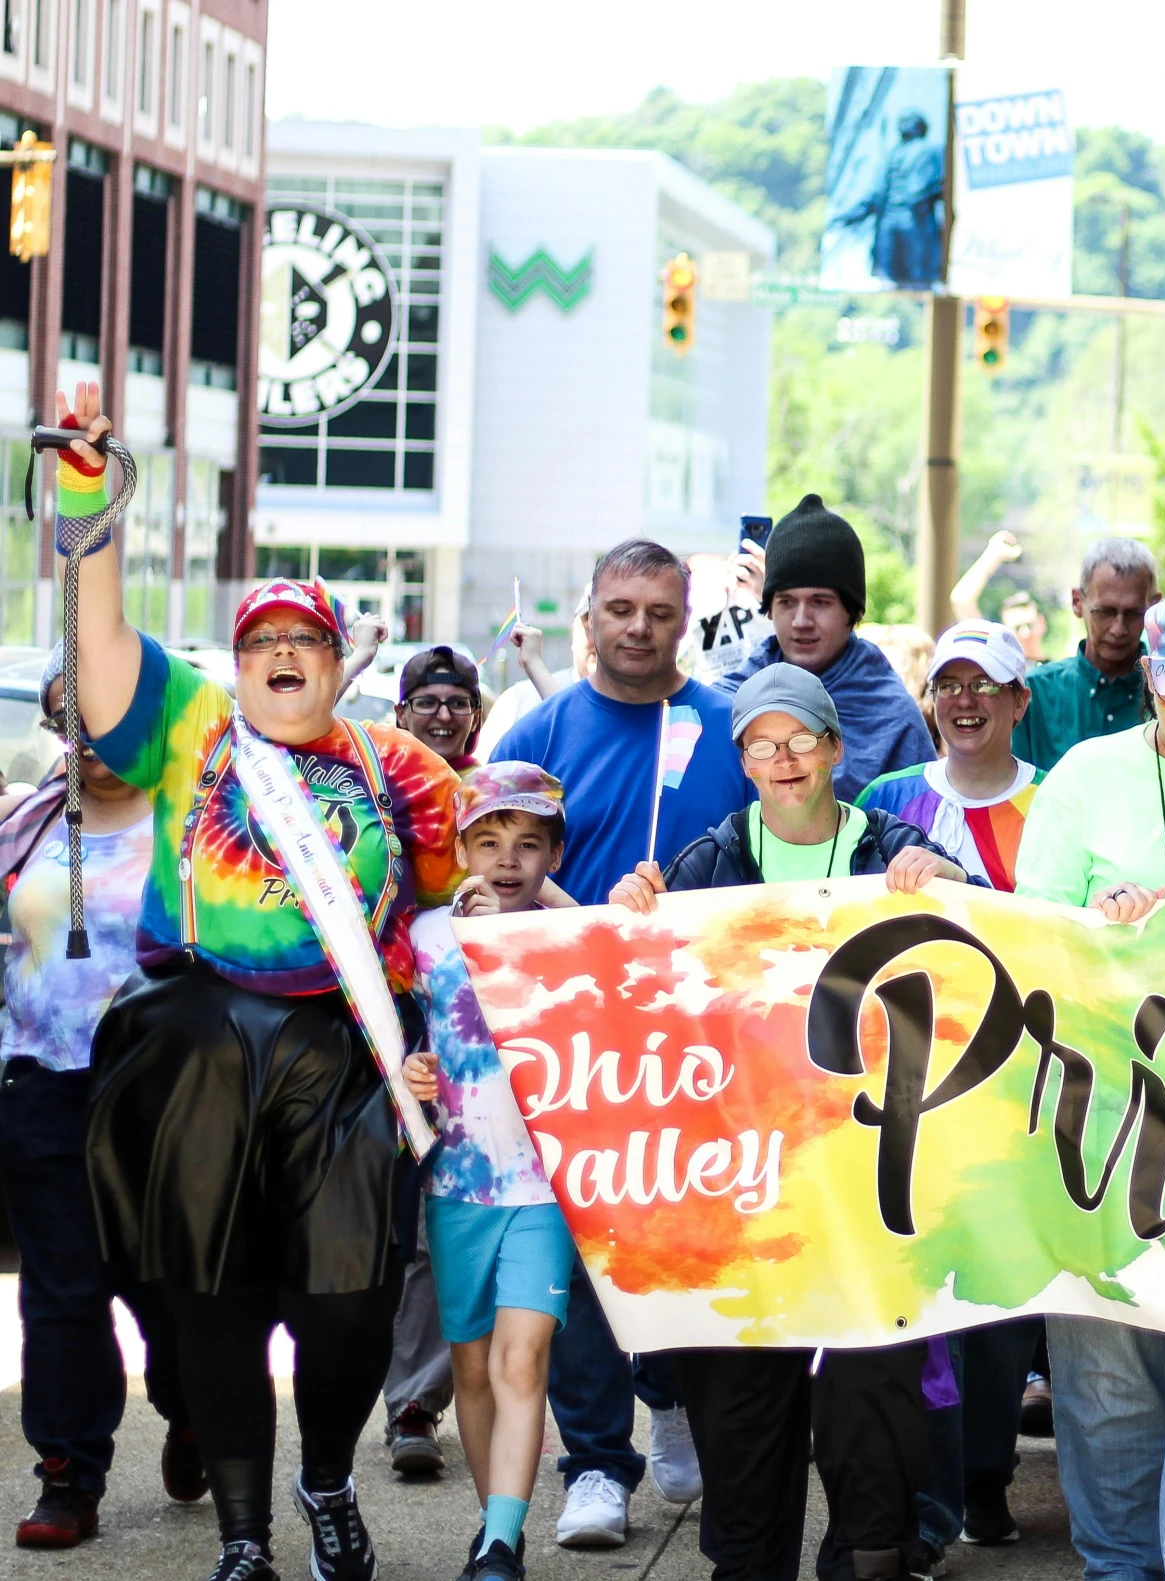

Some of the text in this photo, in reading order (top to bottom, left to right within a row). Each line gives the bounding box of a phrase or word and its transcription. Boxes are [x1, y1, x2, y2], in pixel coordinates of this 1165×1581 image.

[957, 93, 1063, 136] DOWN
[961, 126, 1072, 166] TOWN
[498, 1031, 735, 1121] Ohio
